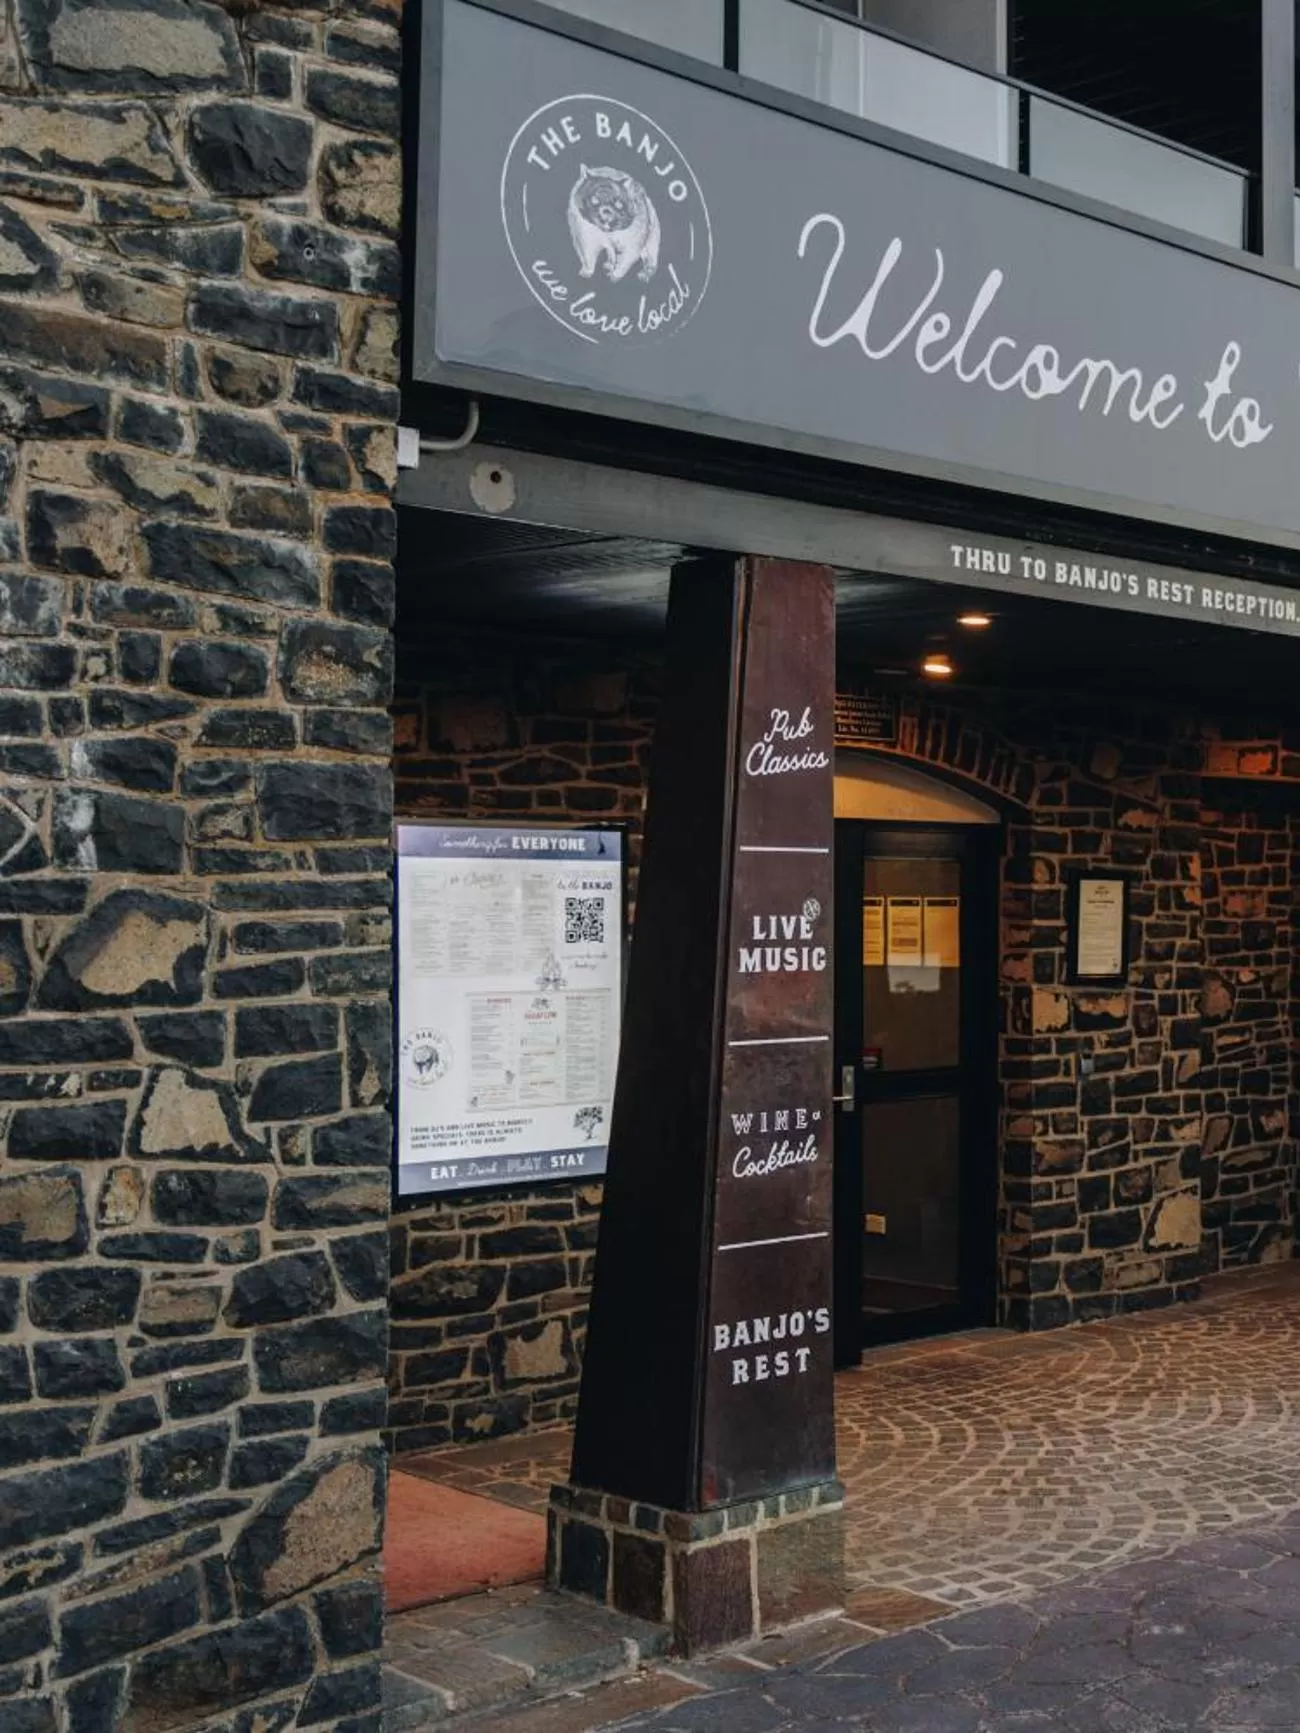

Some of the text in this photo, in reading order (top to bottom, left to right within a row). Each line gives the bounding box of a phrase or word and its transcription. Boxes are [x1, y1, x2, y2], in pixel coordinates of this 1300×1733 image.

[526, 111, 688, 202] THE BANJO
[531, 260, 568, 301] we
[569, 291, 633, 336] love
[798, 213, 1184, 430] Welcome
[1198, 341, 1274, 448] to
[950, 545, 1012, 575] THRU
[1020, 556, 1047, 581] TO
[1054, 562, 1139, 596] BANJO'S
[1146, 577, 1195, 605] REST
[763, 706, 815, 743] Pub
[745, 742, 830, 776] Classics
[511, 835, 587, 852] EVERYONE
[581, 880, 613, 890] BANJO
[752, 915, 815, 941] LIVE
[738, 945, 828, 974] MUSIC
[731, 1108, 808, 1135] WINE
[430, 1165, 458, 1181] EAT
[550, 1152, 585, 1169] STAY
[732, 1134, 819, 1179] Cocktails
[713, 1307, 831, 1352] BANJO'S
[731, 1347, 813, 1386] REST
